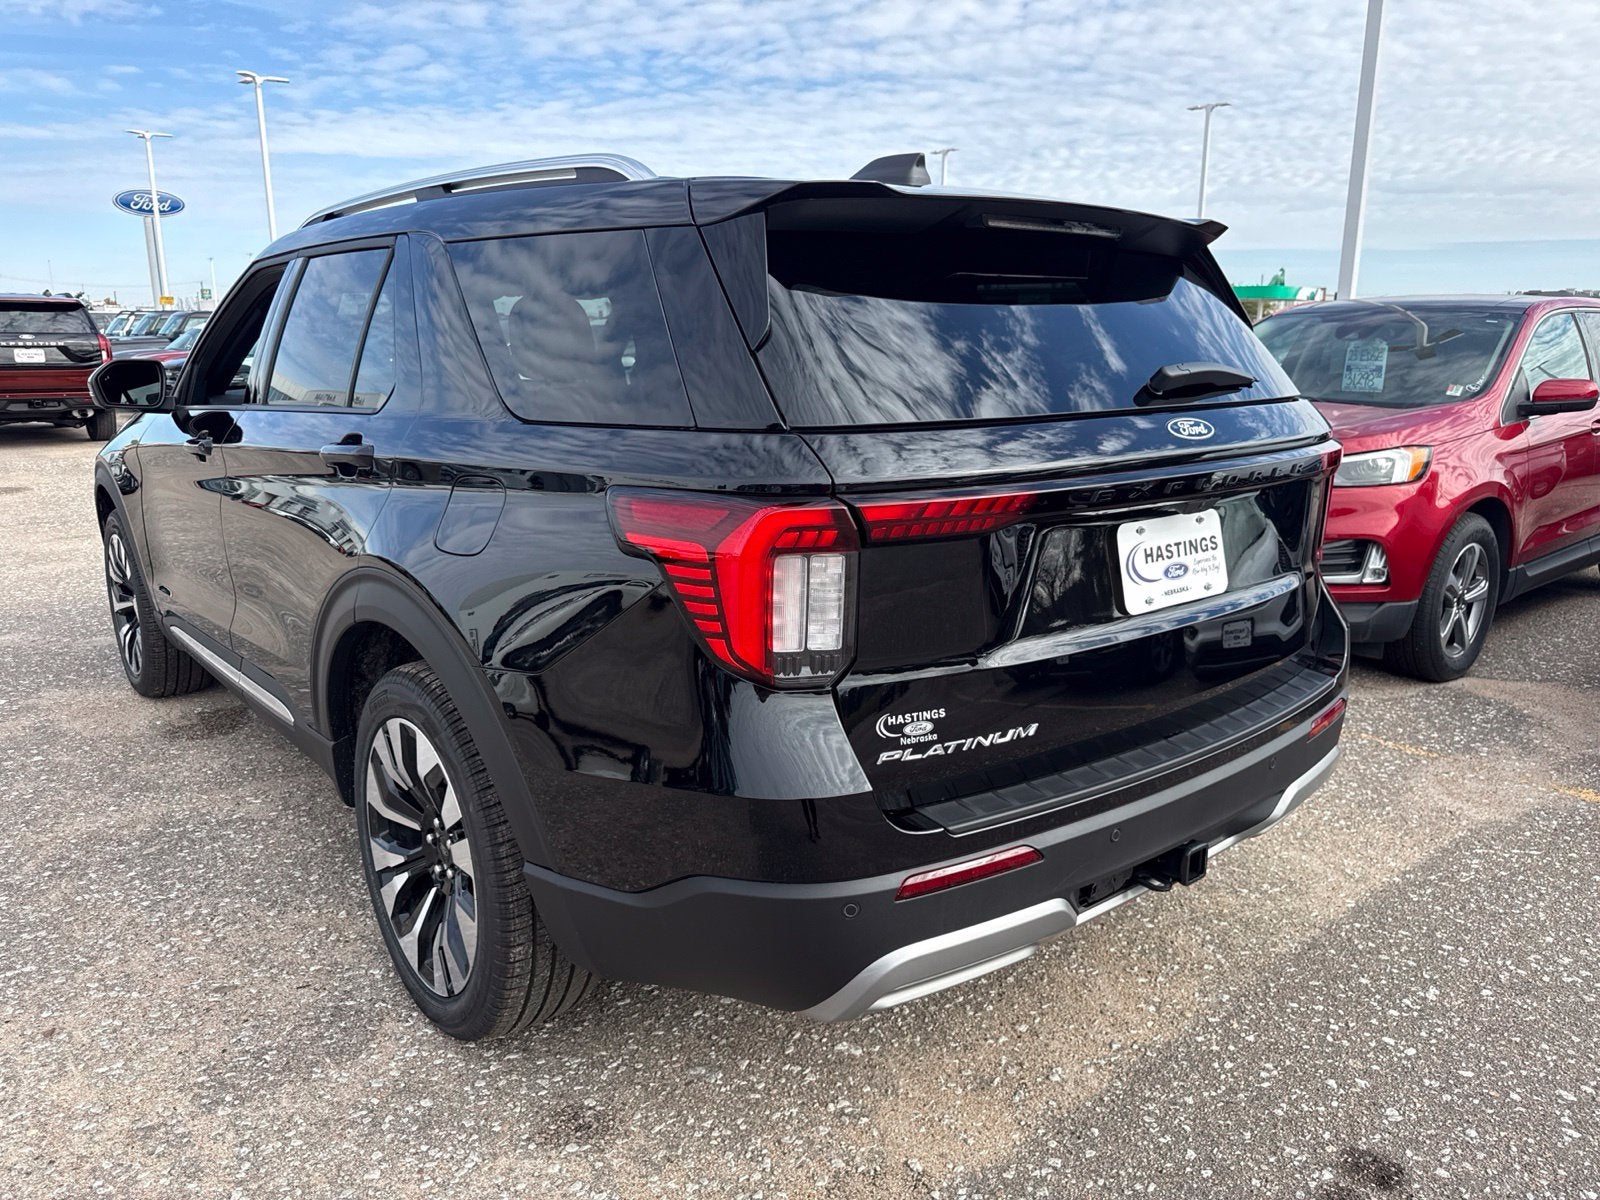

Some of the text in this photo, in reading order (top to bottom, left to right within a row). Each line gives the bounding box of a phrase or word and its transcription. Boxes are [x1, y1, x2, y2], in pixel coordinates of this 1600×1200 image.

[130, 193, 171, 211] Fod
[1177, 420, 1208, 435] Ford
[1144, 535, 1218, 564] HASTINGS
[1167, 564, 1185, 579] Ford
[887, 708, 946, 726] HASTINGS
[876, 723, 1039, 765] PLATINUM
[900, 733, 938, 746] Nebraska
